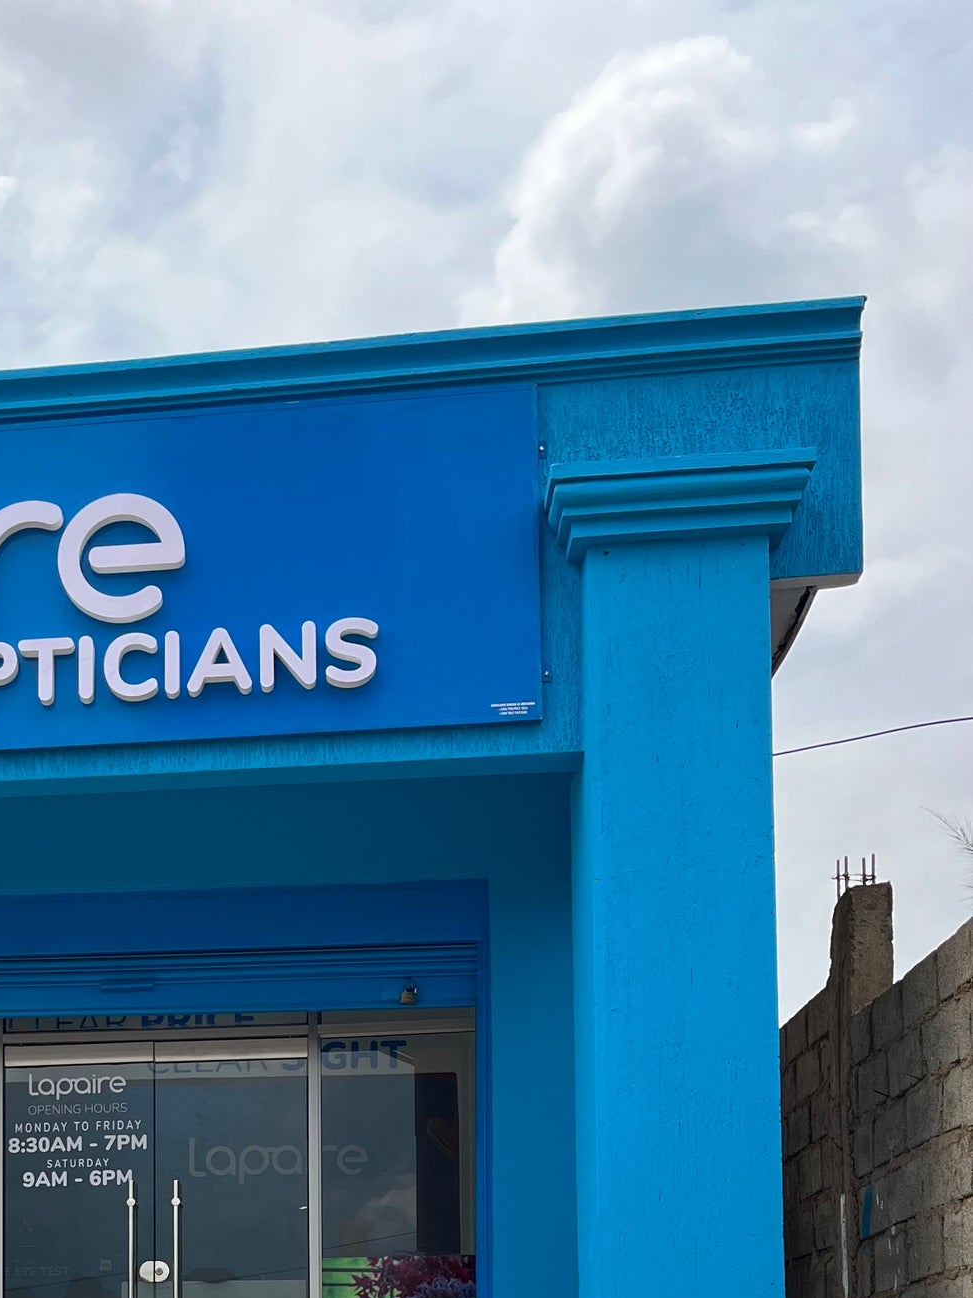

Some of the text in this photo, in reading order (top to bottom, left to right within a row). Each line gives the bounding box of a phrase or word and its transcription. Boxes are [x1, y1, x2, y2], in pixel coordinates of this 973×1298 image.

[282, 1041, 407, 1071] SGHT
[28, 1073, 127, 1100] Lapaire
[28, 1102, 128, 1116] OPENING HOURS
[15, 1119, 142, 1133] MONDAY TO FRIDAY
[8, 1135, 83, 1153] 8:30AM
[104, 1134, 147, 1151] 7PM
[47, 1158, 109, 1169] SATURDAY
[189, 1138, 369, 1185] Lapae
[22, 1171, 68, 1188] 9AM
[89, 1169, 134, 1186] 6PM
